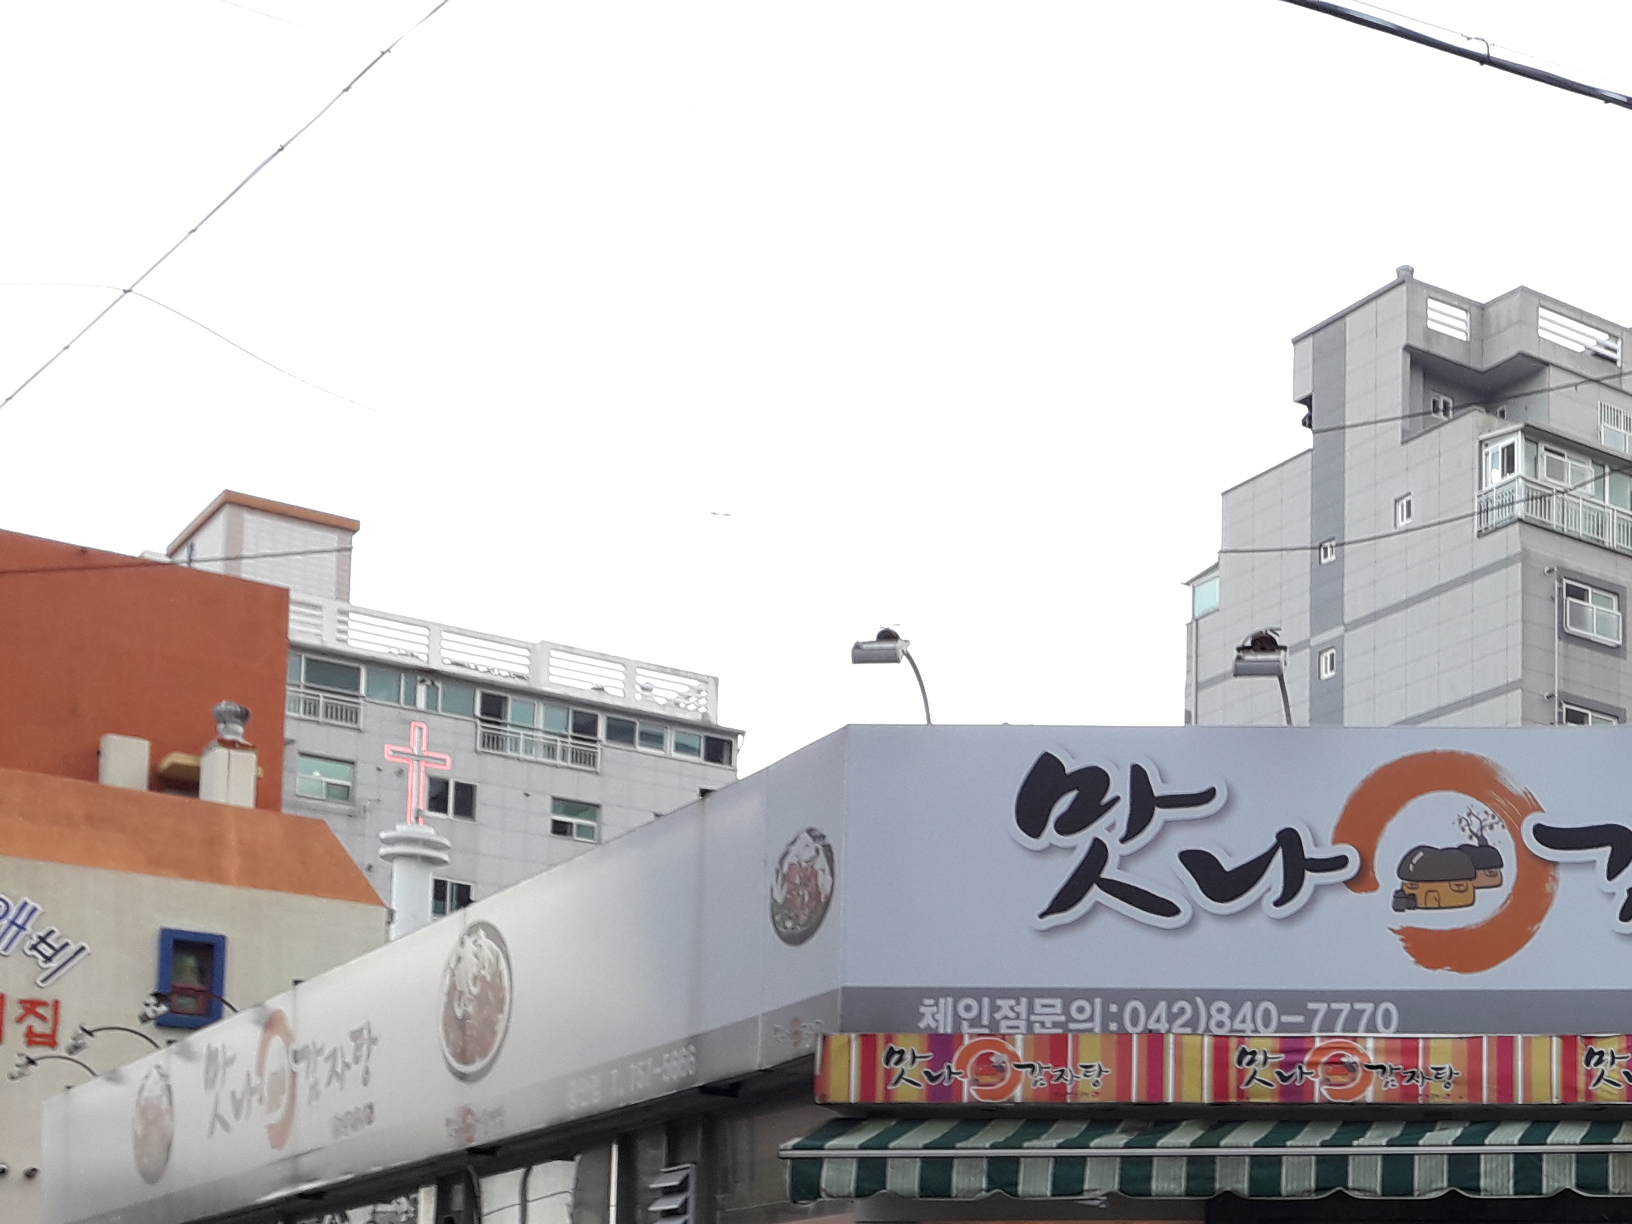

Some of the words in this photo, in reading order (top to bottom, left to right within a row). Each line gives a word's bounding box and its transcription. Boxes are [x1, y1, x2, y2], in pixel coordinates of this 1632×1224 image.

[1015, 750, 1350, 921] 맛나
[917, 997, 1400, 1034] 체인점문의:042)840-7770
[883, 1045, 965, 1088] 맛나
[1012, 1061, 1110, 1088] 감자탕
[1236, 1046, 1317, 1088] 맛나
[1364, 1062, 1462, 1089] 감자탕
